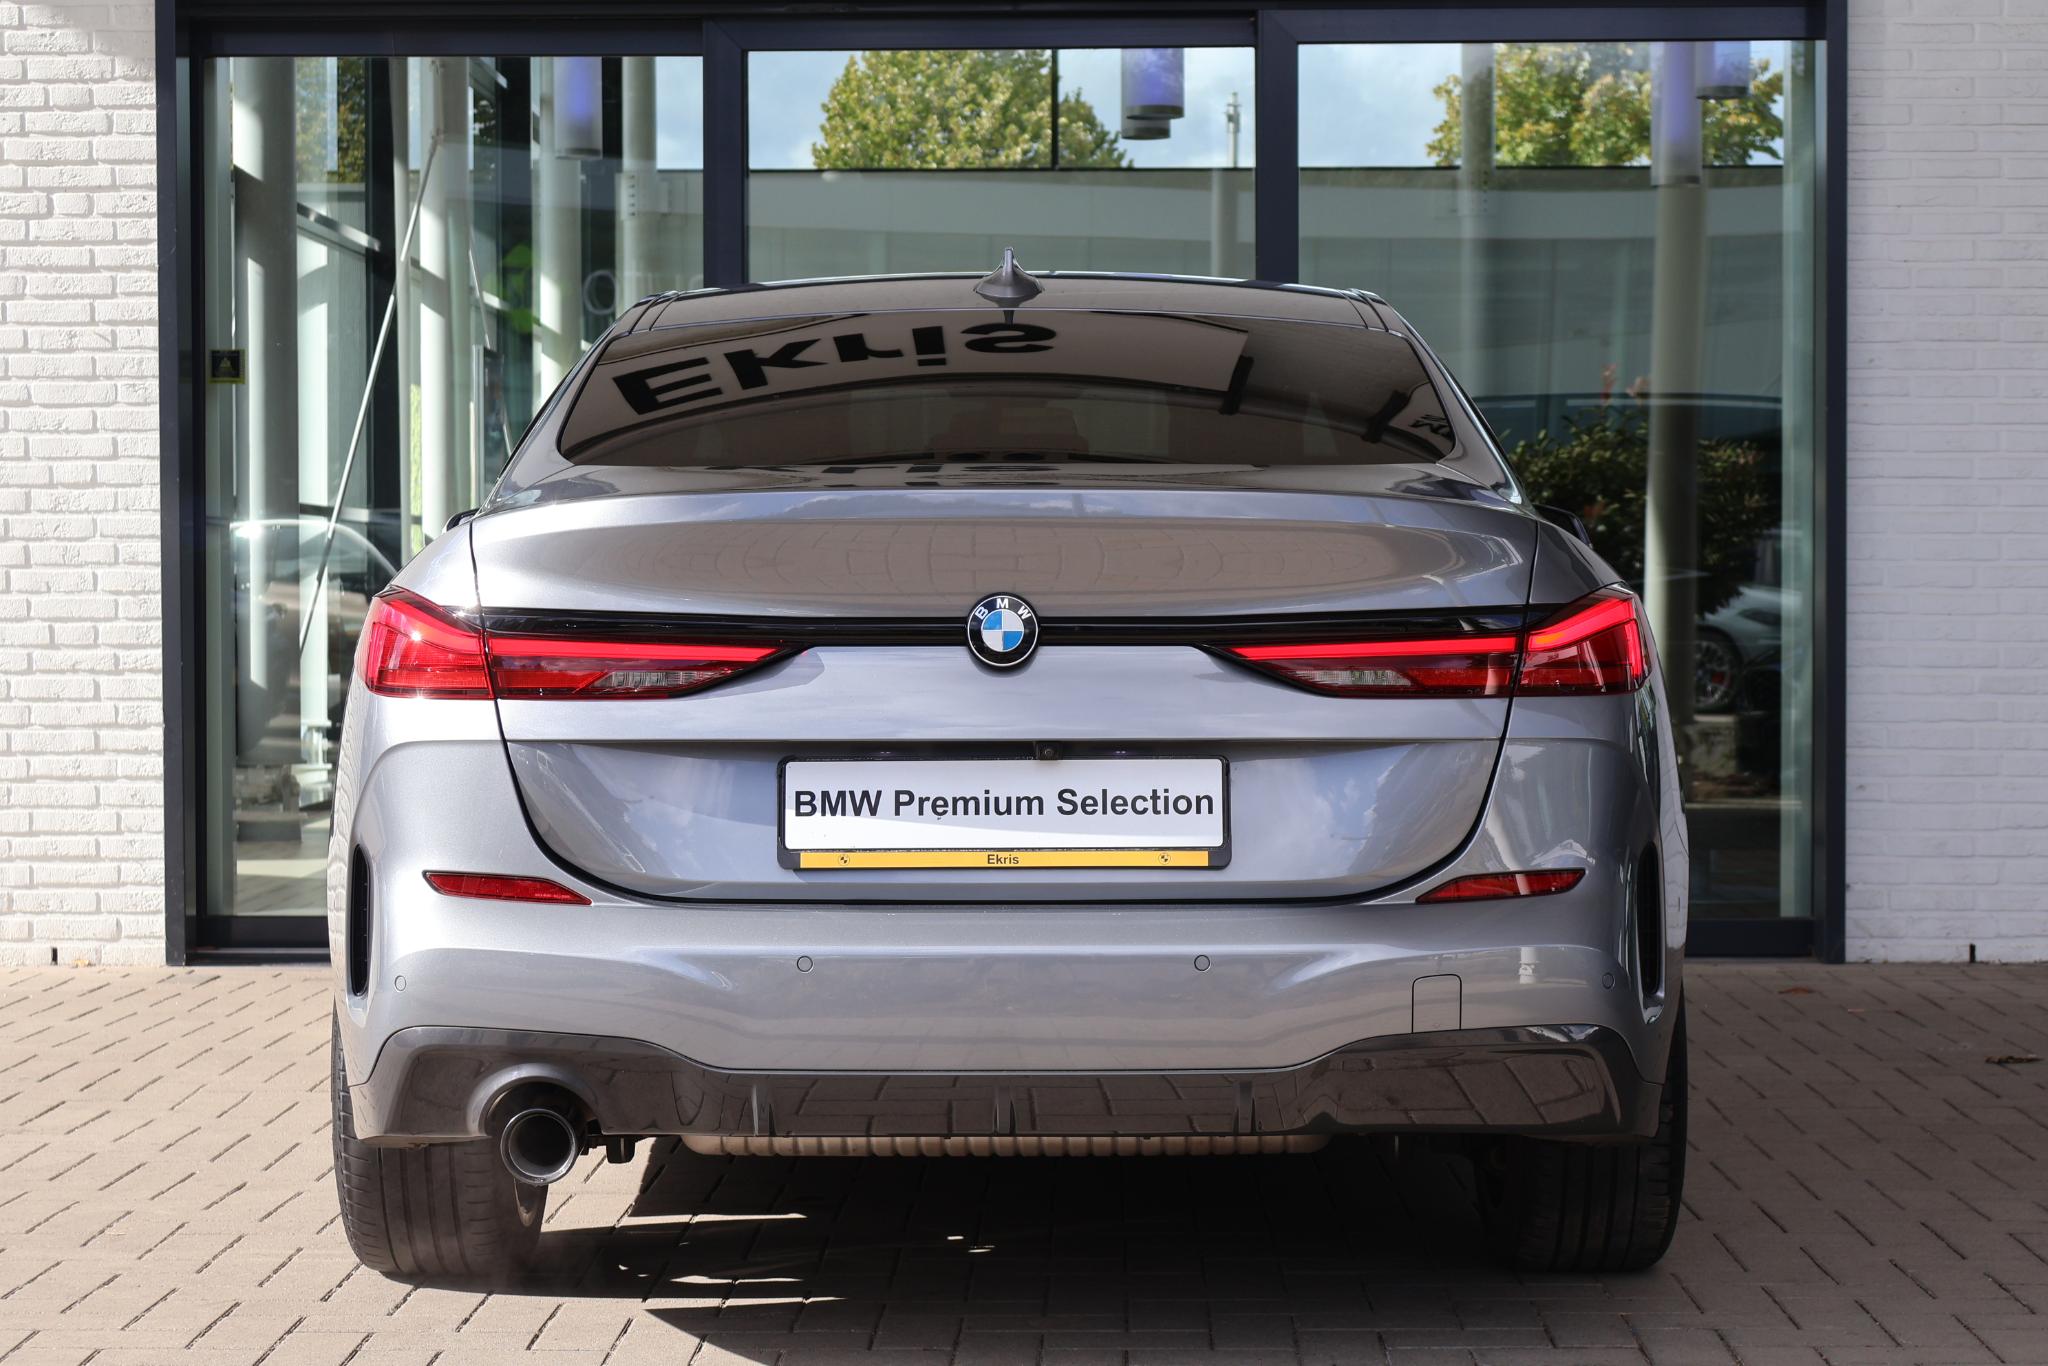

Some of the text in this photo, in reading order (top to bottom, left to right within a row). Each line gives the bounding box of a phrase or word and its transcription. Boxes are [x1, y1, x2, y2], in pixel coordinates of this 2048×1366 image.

[974, 597, 1032, 620] BMW
[794, 788, 1215, 817] BMW Premium Selection
[987, 853, 1020, 865] Ekris
